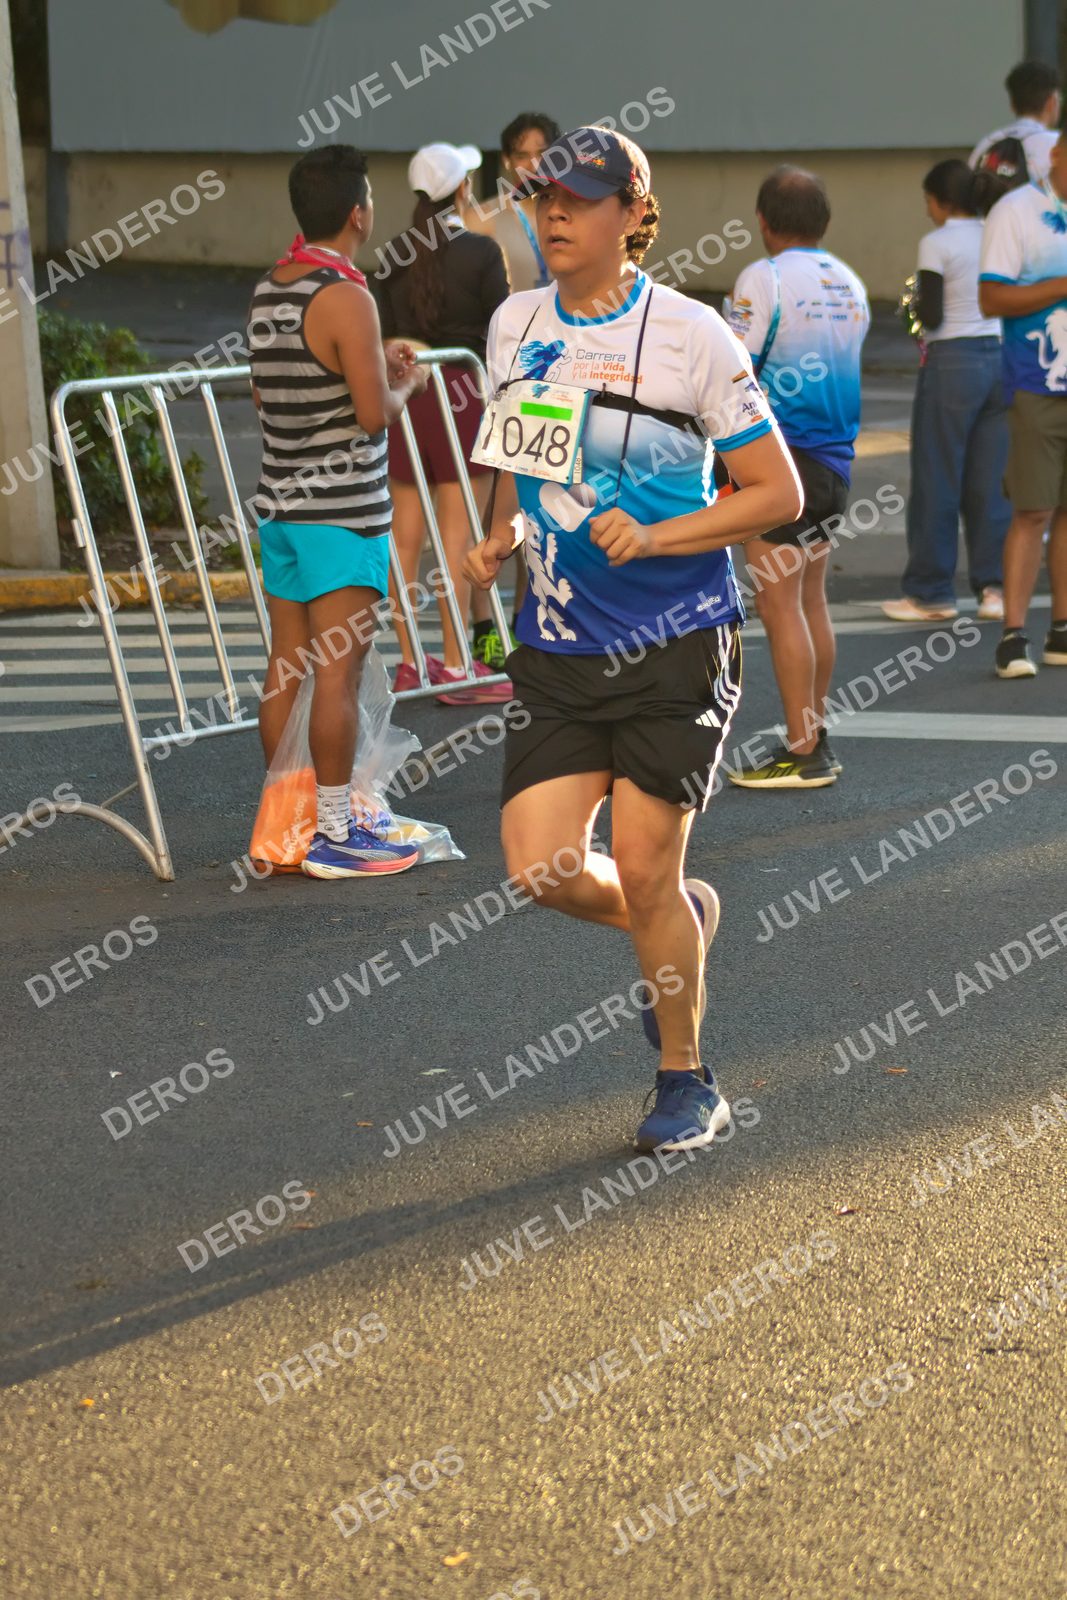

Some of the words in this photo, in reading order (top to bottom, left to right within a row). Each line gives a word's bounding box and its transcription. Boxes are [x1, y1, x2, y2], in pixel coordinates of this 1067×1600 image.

[576, 349, 626, 362] Carrera
[573, 362, 589, 371] por
[591, 362, 600, 371] la
[602, 362, 625, 372] Vida
[590, 371, 643, 385] Integridad
[482, 412, 570, 467] 1048
